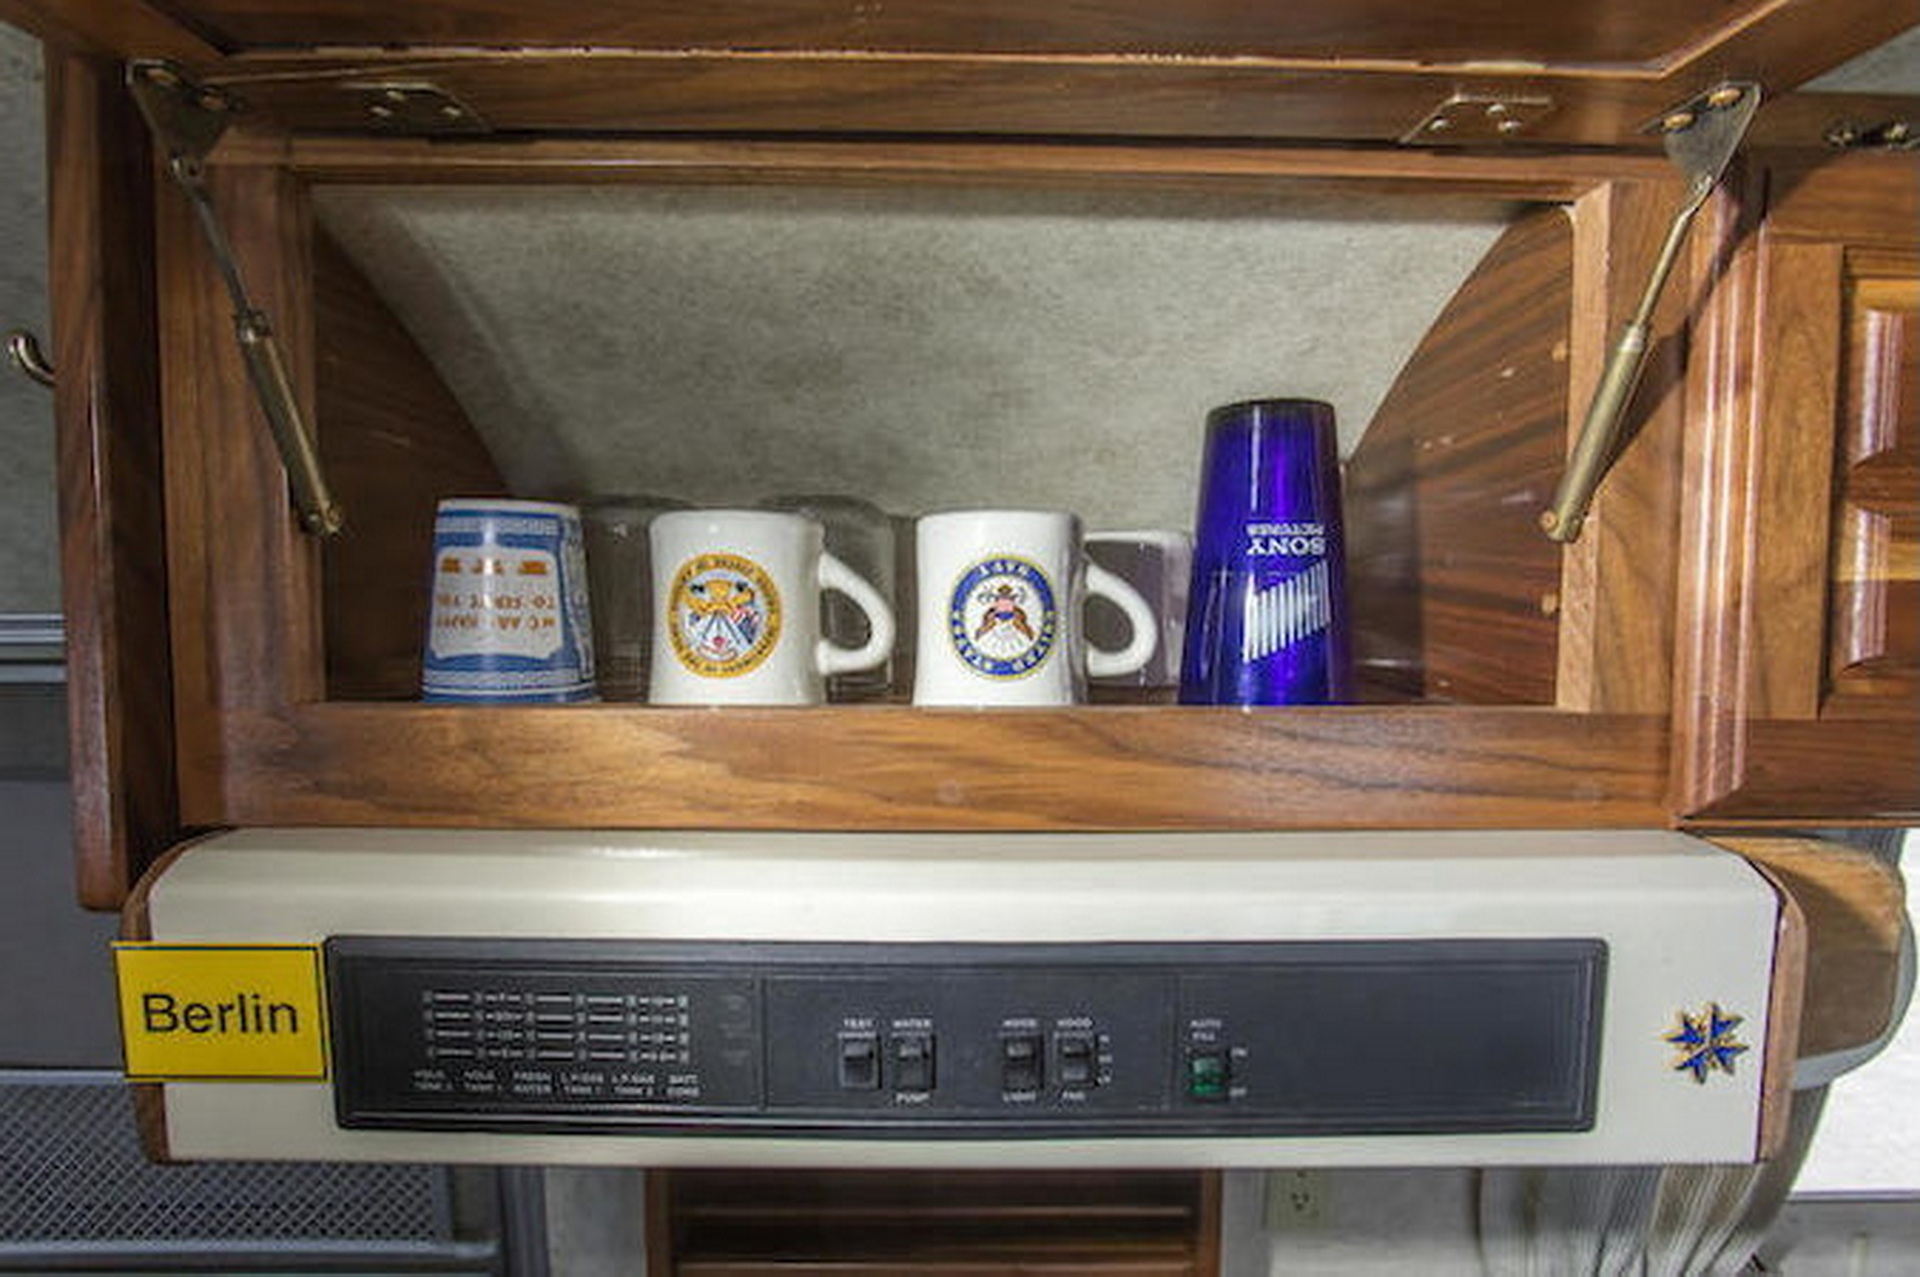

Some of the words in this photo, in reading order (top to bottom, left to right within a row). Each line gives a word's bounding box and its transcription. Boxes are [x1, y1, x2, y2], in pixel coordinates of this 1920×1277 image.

[1246, 537, 1325, 556] SONY
[470, 595, 524, 610] SERE
[141, 993, 298, 1034] Berlin
